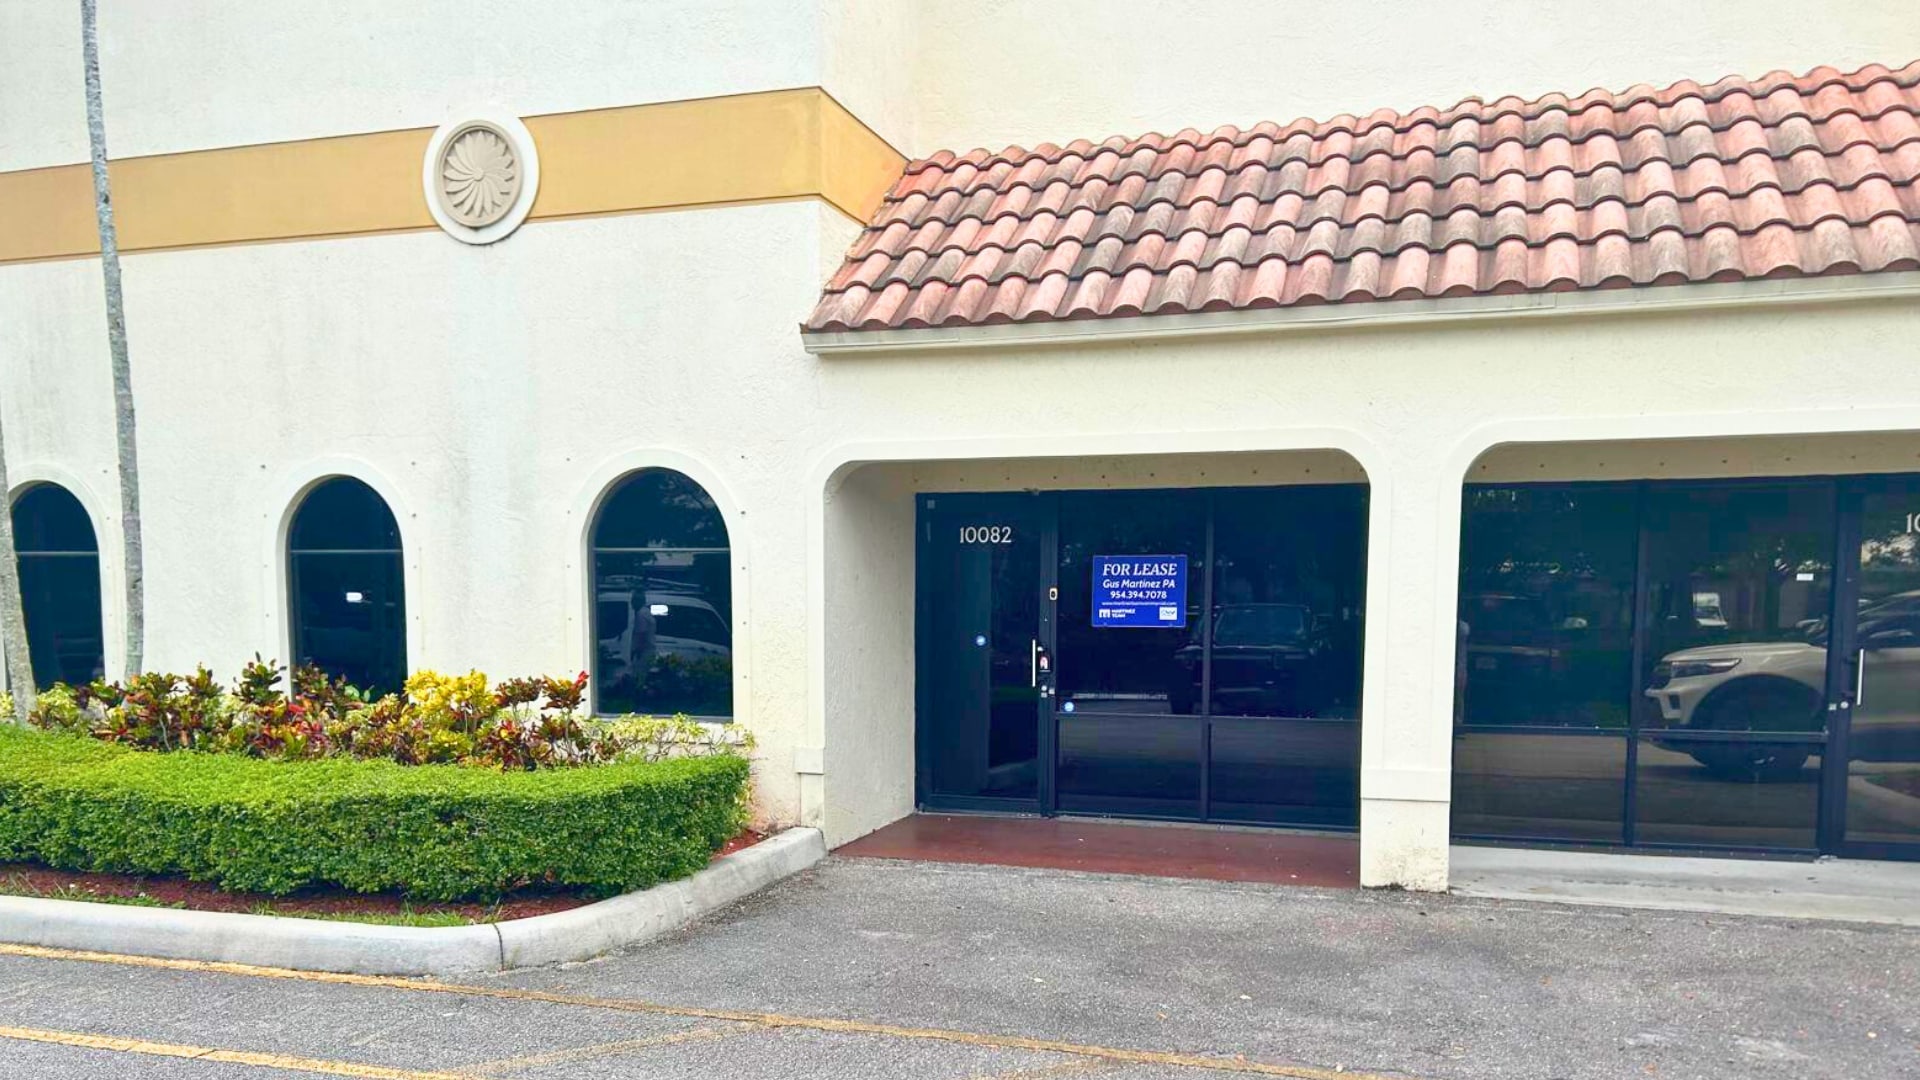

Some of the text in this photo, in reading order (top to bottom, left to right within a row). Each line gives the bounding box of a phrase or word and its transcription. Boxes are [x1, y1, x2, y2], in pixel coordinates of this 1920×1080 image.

[959, 526, 1012, 544] 10082
[1102, 563, 1178, 576] FOR LEASE
[1102, 578, 1176, 589] Gus Martinez PA
[1110, 590, 1167, 599] 954.394.7078
